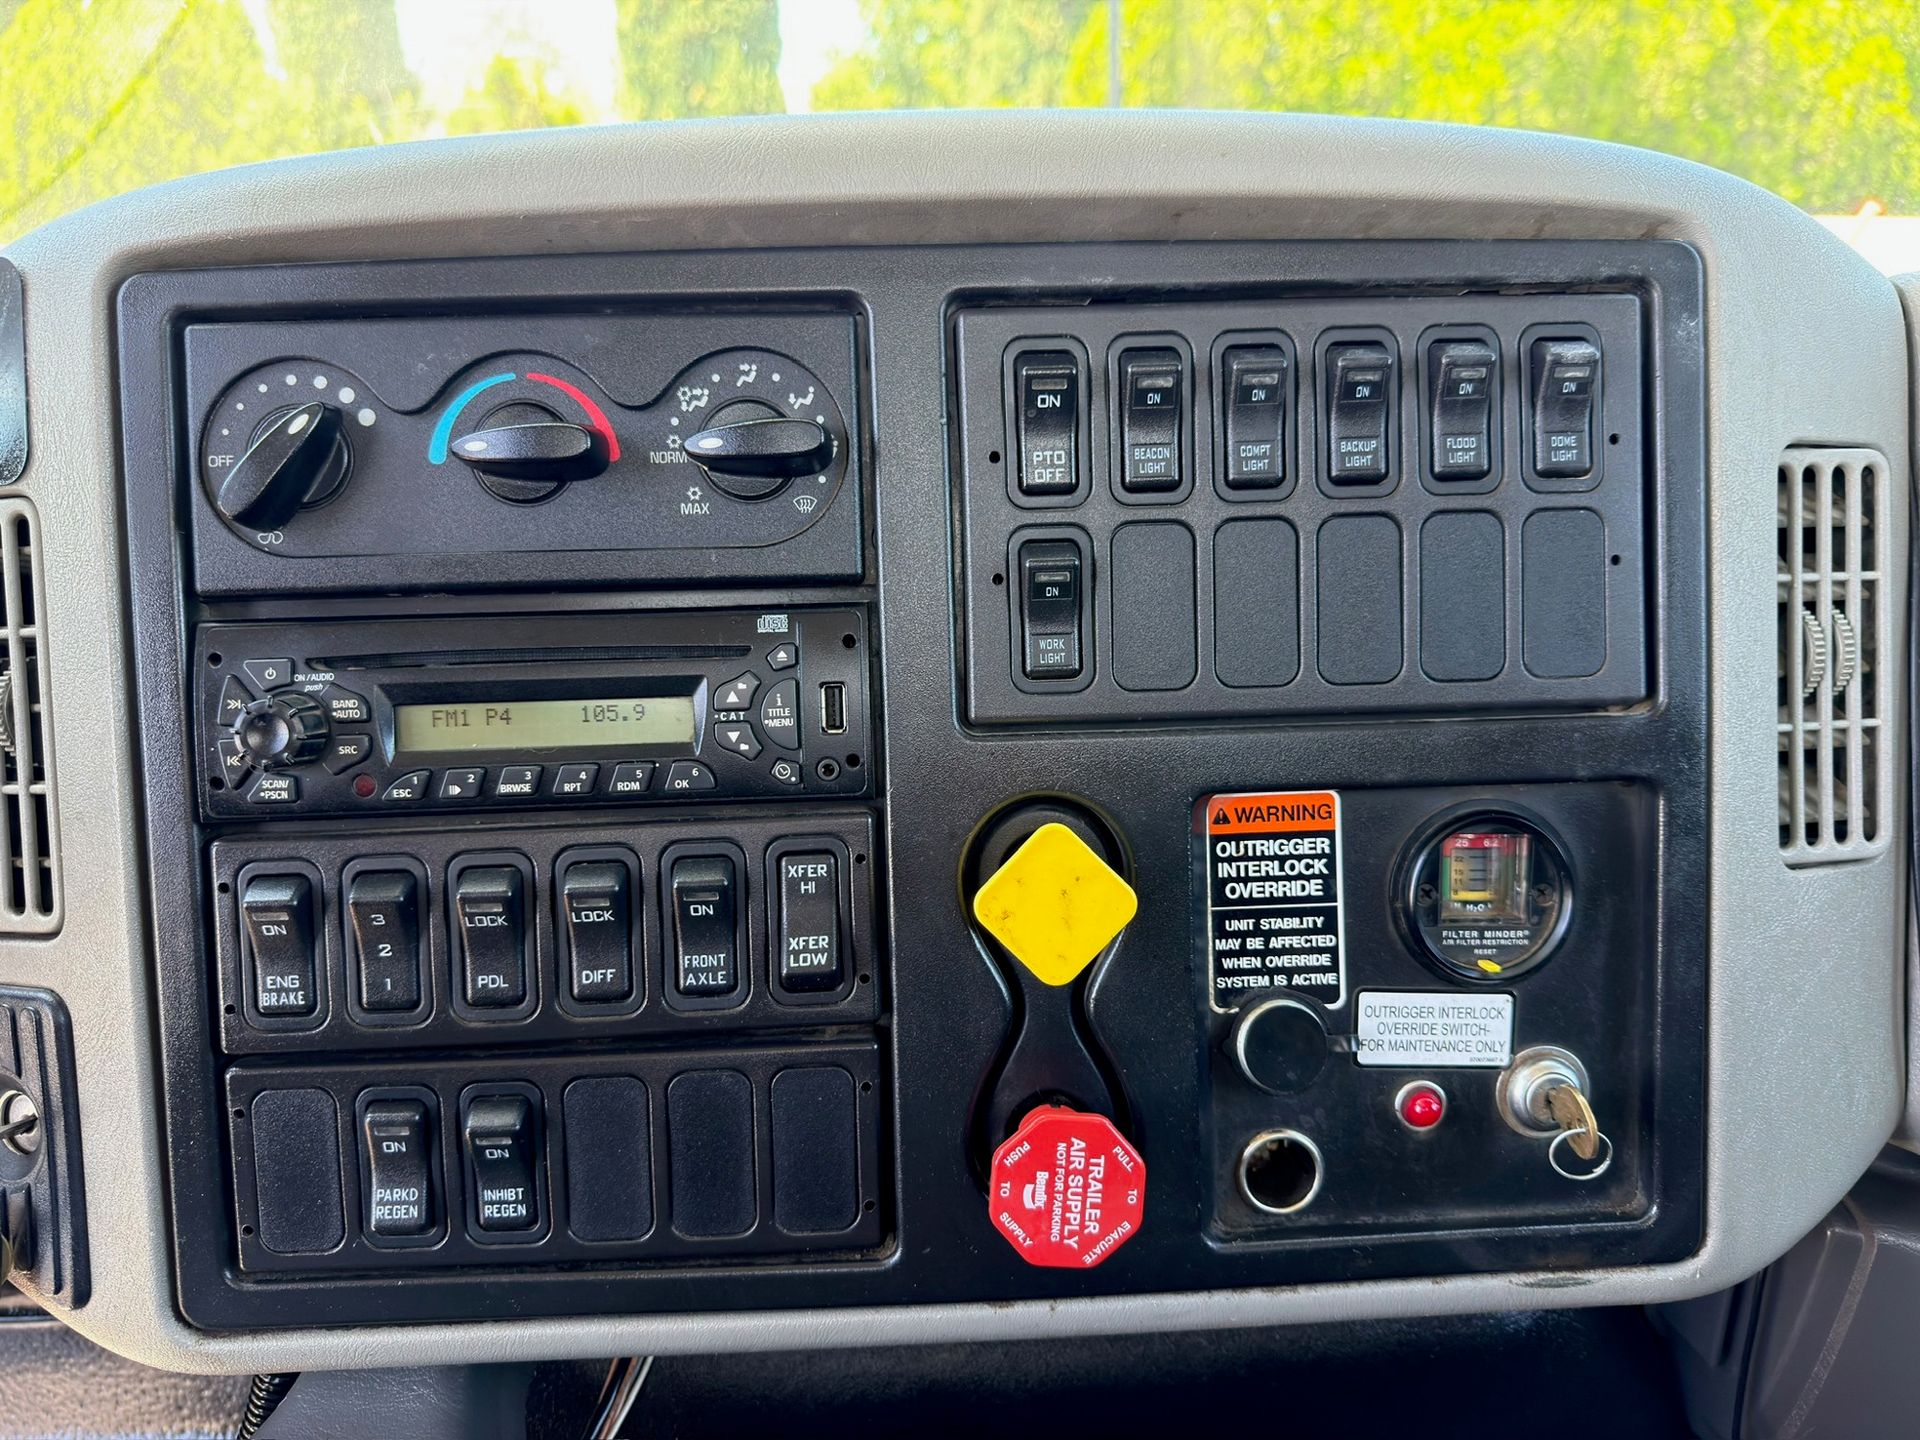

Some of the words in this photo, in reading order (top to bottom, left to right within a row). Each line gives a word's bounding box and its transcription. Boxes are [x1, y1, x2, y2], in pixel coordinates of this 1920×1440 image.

[1355, 385, 1370, 398] ON
[1459, 383, 1473, 395] ON
[1562, 382, 1576, 393] ON
[1037, 395, 1061, 408] ON
[1146, 393, 1161, 405] ON
[1251, 389, 1266, 401] ON
[1340, 440, 1377, 452] BACKUP
[1446, 437, 1477, 449] FLOOD
[1551, 436, 1577, 447] DOME
[650, 451, 688, 464] NORM
[1134, 447, 1170, 460] BEACON
[1240, 445, 1270, 457] COMPT
[1448, 451, 1475, 463] LIGHT
[1551, 449, 1578, 462] LIGHT
[208, 455, 234, 467] OFF
[1033, 451, 1066, 465] PTO
[1345, 455, 1373, 467] LIGHT
[1139, 462, 1165, 474] LIGHT
[1242, 459, 1269, 471] LIGHT
[1034, 468, 1065, 482] OFF
[680, 502, 710, 515] MAX
[1045, 586, 1059, 597] ON
[1039, 639, 1065, 650] WORK
[1039, 653, 1066, 664] LIGHT
[304, 683, 323, 692] push
[333, 700, 358, 708] BAND
[431, 709, 470, 728] FM1
[486, 708, 512, 726] P4
[581, 703, 645, 723] 105.9
[339, 746, 358, 754] SRC
[467, 774, 475, 783] 2
[524, 771, 532, 780] 3
[579, 771, 587, 780] 4
[636, 770, 643, 779] 5
[692, 768, 699, 776] 6
[500, 783, 532, 793] BRWSE
[564, 782, 582, 792] RPT
[617, 781, 640, 790] RDM
[675, 780, 689, 788] OK
[394, 789, 412, 798] ESC
[1234, 803, 1333, 823] WARNING
[1215, 837, 1331, 858] OUTRIGGER
[1455, 838, 1469, 847] 25
[788, 865, 827, 878] XFER
[1217, 858, 1329, 878] INTERLOCK
[801, 881, 816, 894] HI
[1225, 879, 1324, 899] OVERRIDE
[572, 910, 615, 923] LOCK
[690, 904, 714, 916] ON
[371, 914, 386, 925] 3
[465, 915, 508, 927] LOCK
[1225, 919, 1256, 932] UNIT
[1259, 916, 1324, 930] STABILITY
[262, 925, 287, 936] ON
[1442, 930, 1478, 938] FILTER
[789, 936, 828, 950] XFER
[1215, 938, 1242, 951] MAY
[1246, 937, 1265, 949] BE
[1269, 934, 1337, 948] AFFECTED
[379, 944, 392, 956] 2
[684, 954, 726, 969] FRONT
[790, 953, 828, 967] LOW
[1222, 957, 1261, 969] WHEN
[1265, 954, 1332, 968] OVERRIDE
[266, 976, 299, 989] ENG
[478, 975, 509, 988] PDL
[582, 969, 616, 984] DIFF
[686, 971, 727, 985] AXLE
[1216, 975, 1270, 989] SYSTEM
[1273, 975, 1287, 986] IS
[1291, 973, 1339, 986] ACTIVE
[385, 978, 392, 991] 1
[262, 991, 305, 1006] BRAKE
[1364, 1005, 1435, 1019] OUTRIGGER
[1438, 1006, 1504, 1020] INTERLOCK
[1377, 1022, 1438, 1036] OVERRIDE
[1360, 1038, 1385, 1052] FOR
[1388, 1039, 1472, 1053] MAINTENANCE
[1475, 1040, 1506, 1053] ONLY
[382, 1141, 406, 1152] ON
[485, 1149, 510, 1159] ON
[1003, 1141, 1031, 1167] PUSH
[1057, 1142, 1067, 1166] NOT
[1069, 1137, 1086, 1170] AIR
[1112, 1145, 1135, 1173] PULL
[1054, 1168, 1065, 1192] FOR
[376, 1188, 419, 1201] PARKD
[484, 1188, 525, 1201] INHIBT
[1000, 1181, 1010, 1197] TO
[1084, 1155, 1105, 1234] TRAILER
[1127, 1189, 1137, 1204] TO
[376, 1205, 418, 1219] REGEN
[484, 1204, 527, 1217] REGEN
[1064, 1175, 1084, 1249] SUPPLY
[1050, 1193, 1063, 1242] PARKING
[1000, 1211, 1033, 1247] SUPPLY
[1082, 1221, 1132, 1264] EVACUATE
